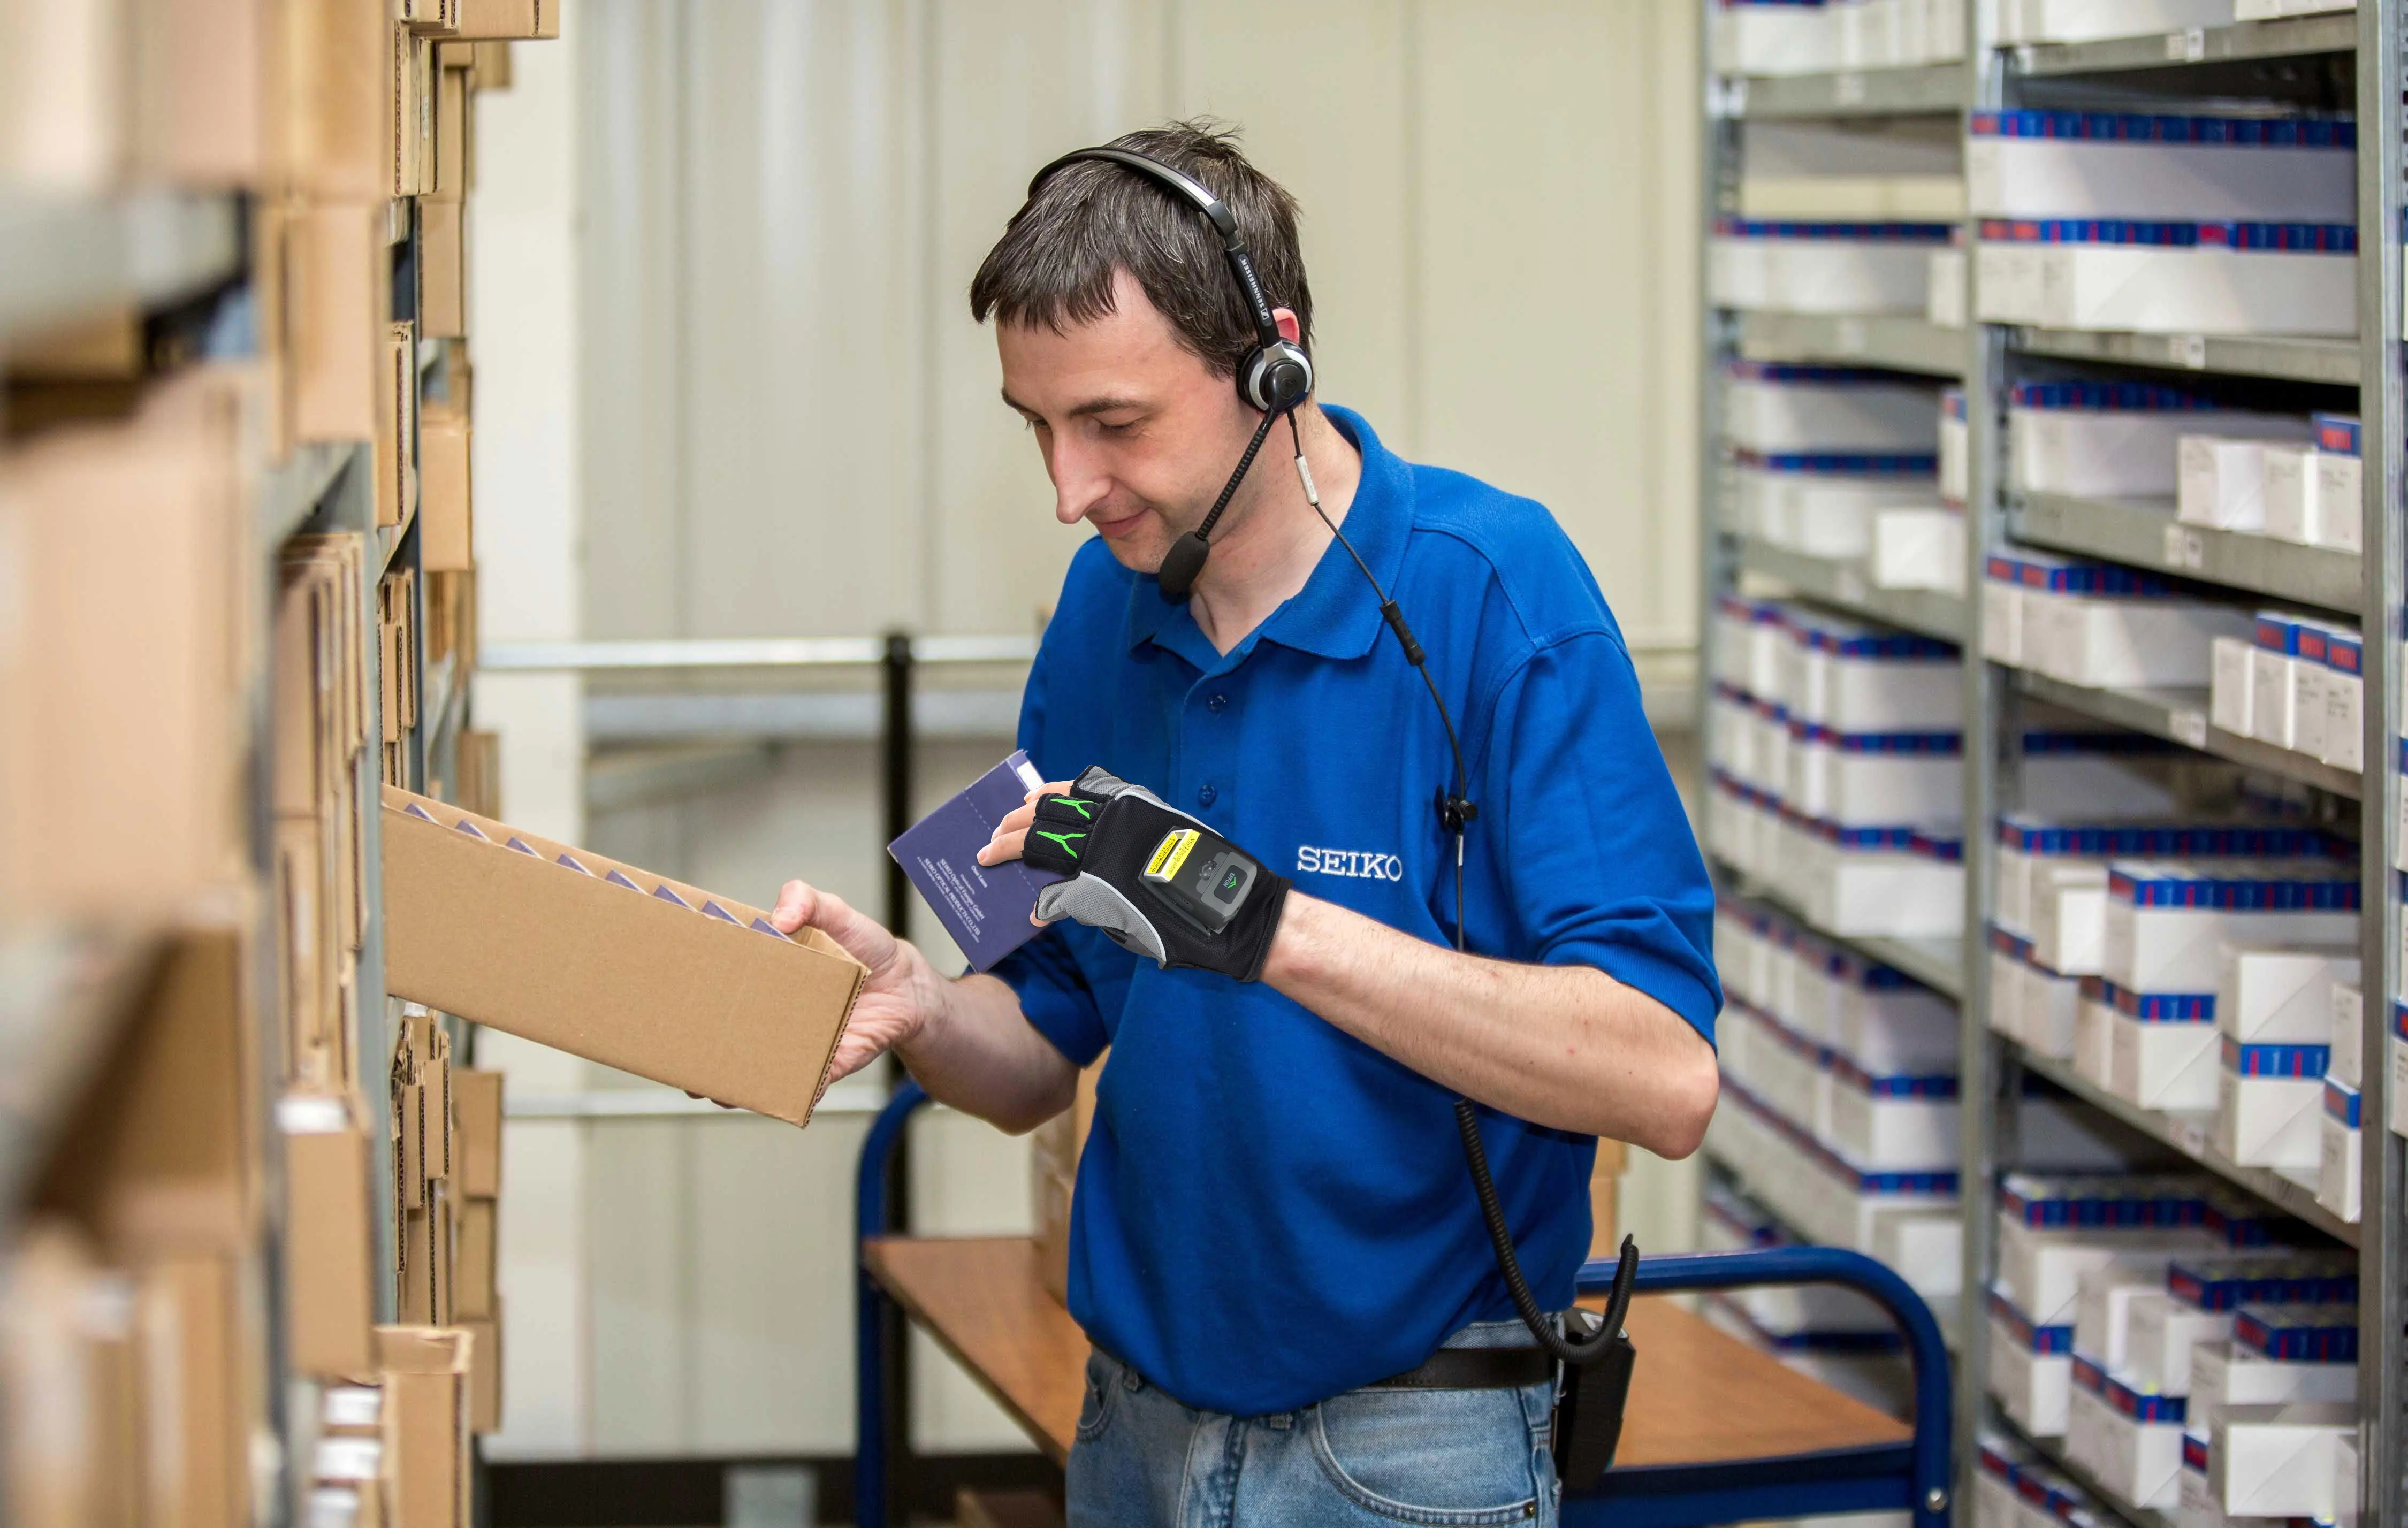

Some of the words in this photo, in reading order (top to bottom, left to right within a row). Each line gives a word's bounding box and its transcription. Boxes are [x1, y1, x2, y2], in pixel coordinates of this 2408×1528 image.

[1241, 258, 1264, 308] SENNHEISER
[1184, 838, 1195, 850] NS02
[940, 858, 952, 875] SEIKO
[1297, 845, 1403, 882] SEIKO
[924, 858, 937, 874] SEIKO
[936, 873, 950, 894] OPTICAL
[949, 891, 969, 918] PRODUCTS
[1223, 872, 1235, 888] EFFON
